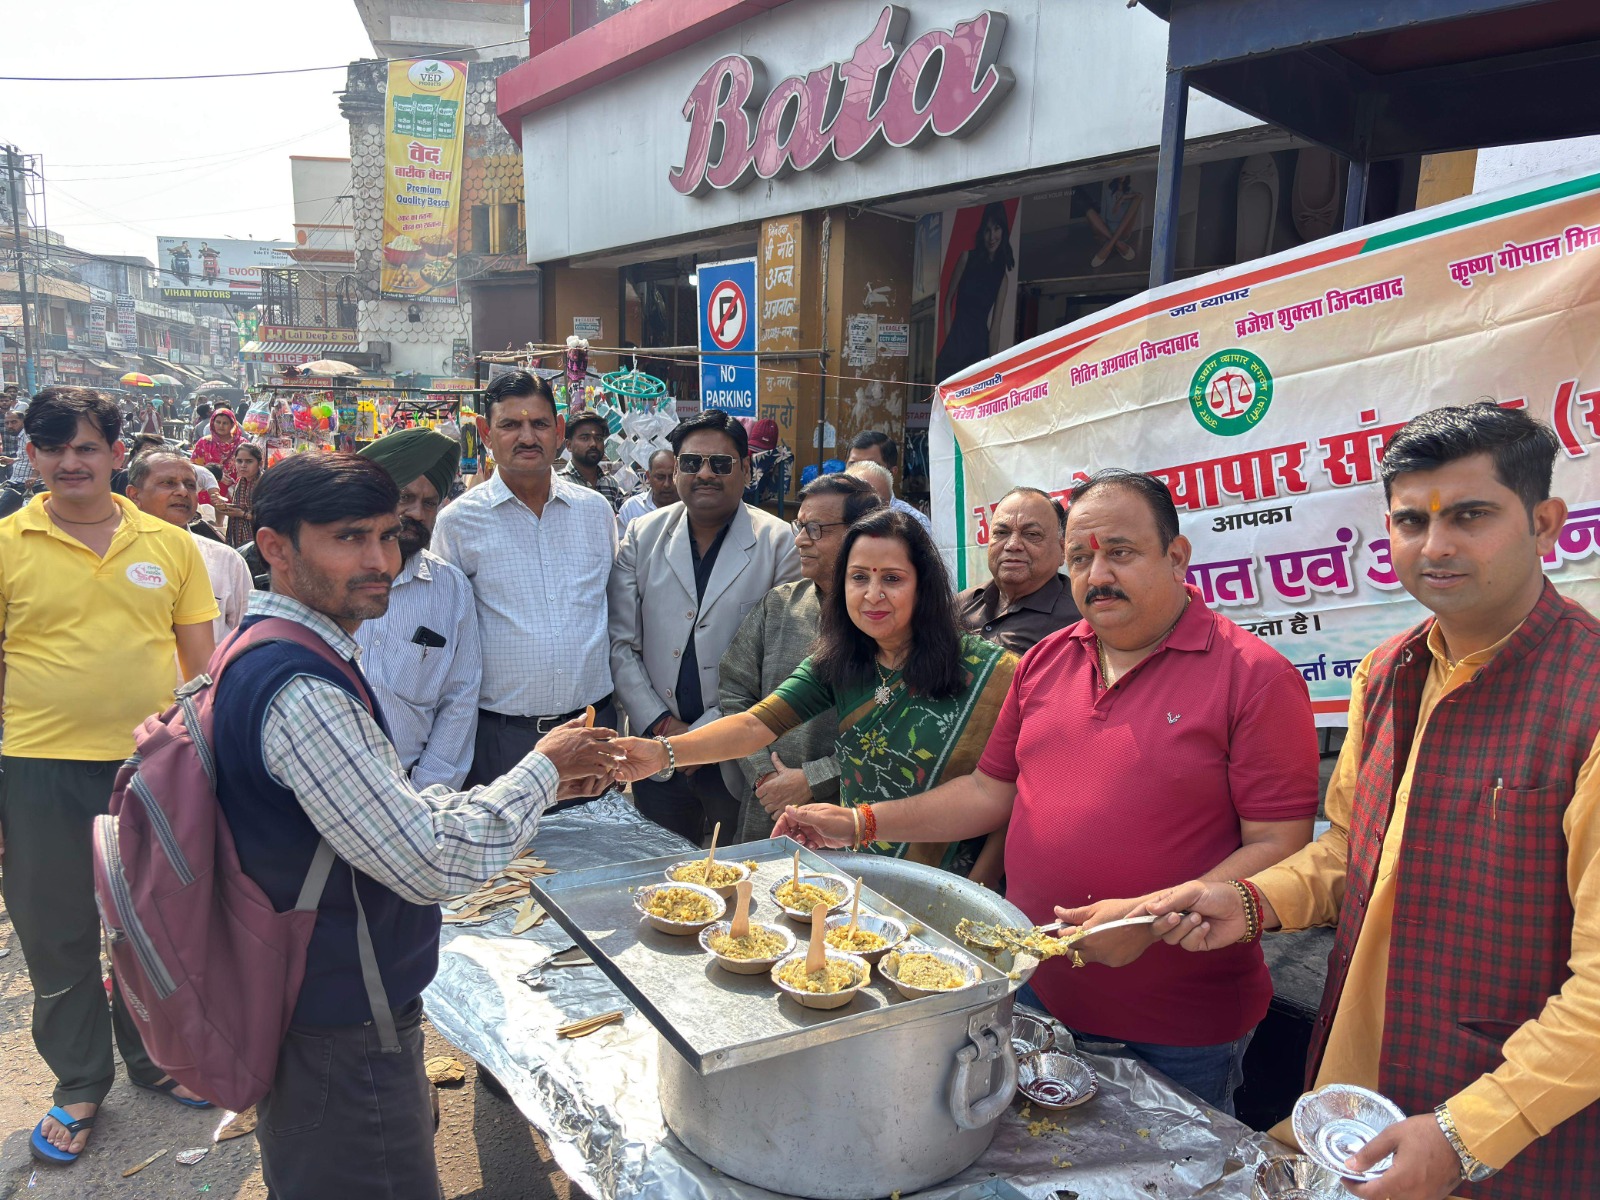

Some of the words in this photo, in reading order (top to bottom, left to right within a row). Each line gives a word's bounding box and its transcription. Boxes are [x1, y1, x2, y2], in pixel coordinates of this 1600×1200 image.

[420, 73, 442, 82] VED
[668, 3, 1012, 197] Bata
[408, 141, 442, 165] वेद
[394, 164, 426, 179] बारीक
[428, 167, 453, 181] बेसन
[406, 183, 442, 195] Premium
[396, 194, 426, 208] Quality
[427, 197, 450, 207] Besan
[1449, 253, 1494, 287] कृष्ण
[1498, 236, 1562, 269] गोपाल
[163, 288, 192, 297] VIHAN
[194, 289, 231, 299] MOTORS
[1169, 303, 1197, 317] जय
[1200, 287, 1251, 309] व्यापार
[1234, 311, 1275, 338] ब्रजेश
[1277, 296, 1324, 331] शुक्ला
[1325, 277, 1404, 315] जिन्दाबाद
[288, 331, 302, 340] Lal
[306, 331, 328, 341] Deep
[331, 331, 338, 340] &
[268, 354, 303, 363] JUICE
[1070, 362, 1099, 387] नितिन
[1100, 347, 1139, 377] अग्रवाल
[1139, 331, 1200, 363] जिन्दाबाद
[1219, 353, 1250, 365] व्यापार
[720, 365, 736, 383] NO
[955, 388, 971, 399] जय
[972, 372, 1003, 393] व्यापारी
[706, 389, 752, 408] PARKING
[952, 407, 975, 421] नरेश
[977, 395, 1009, 419] अग्रवाल
[1009, 381, 1049, 409] जिन्दाबाद
[1211, 504, 1294, 534] आपका
[1265, 526, 1354, 600] एवं
